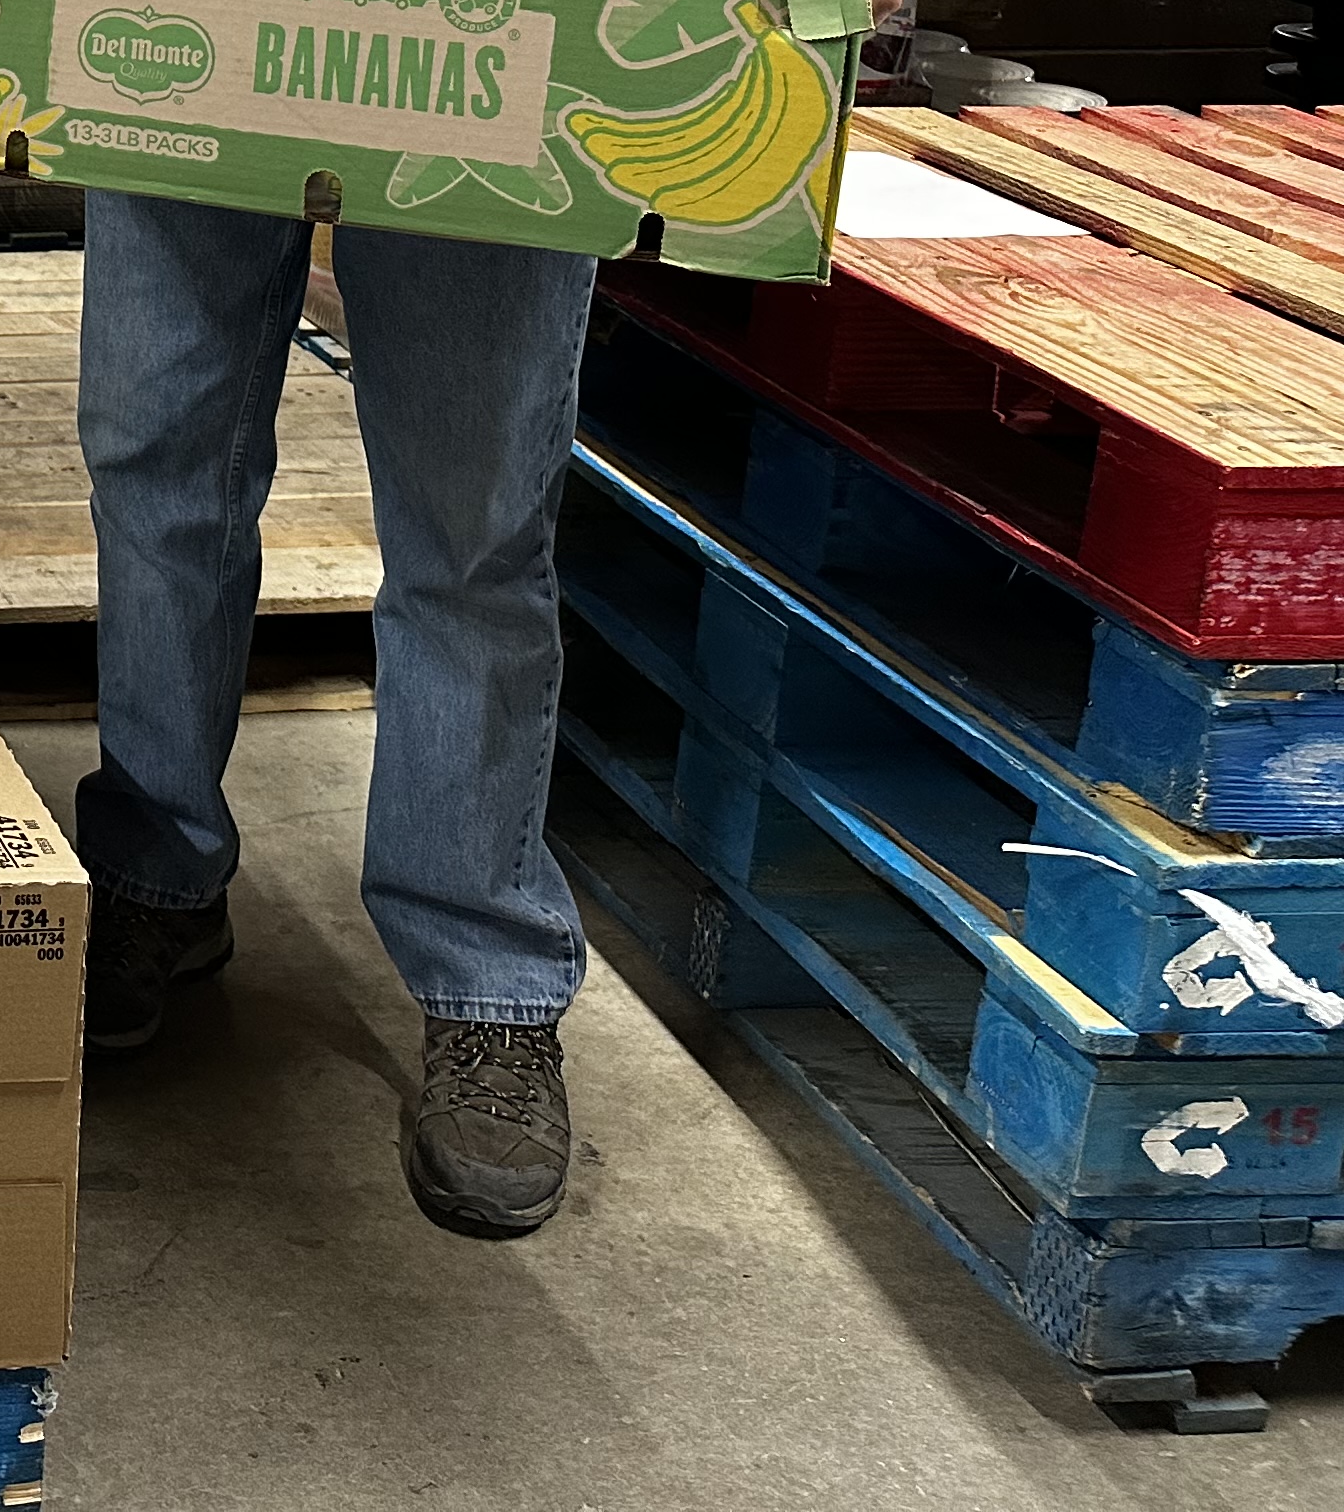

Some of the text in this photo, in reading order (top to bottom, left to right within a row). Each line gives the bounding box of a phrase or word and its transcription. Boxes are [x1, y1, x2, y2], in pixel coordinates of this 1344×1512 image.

[448, 12, 499, 32] PRODUCE
[91, 33, 204, 68] Del Monte
[120, 62, 167, 82] Quality
[253, 22, 506, 120] BANANAS
[70, 123, 214, 157] 13-3 LB PACKS
[15, 894, 42, 905] 65633
[38, 948, 64, 961] 000
